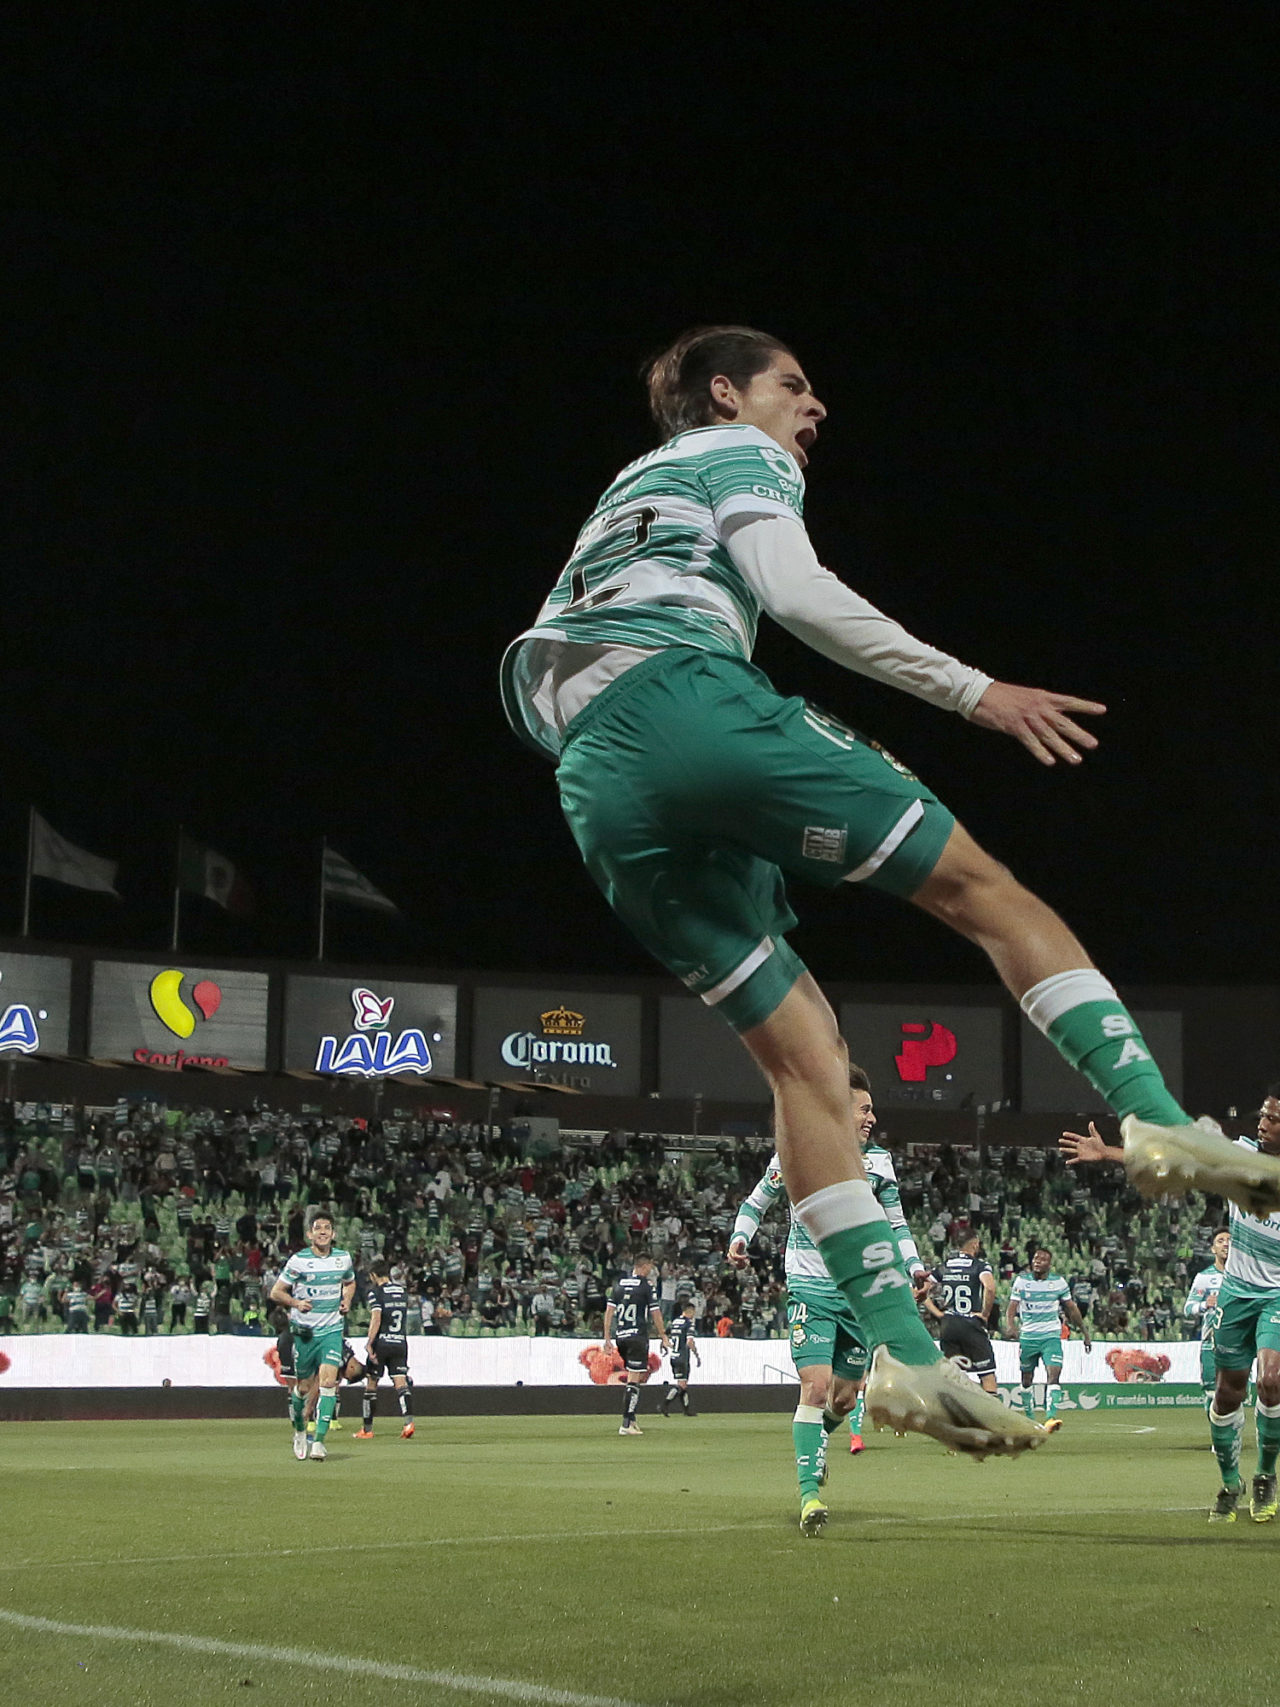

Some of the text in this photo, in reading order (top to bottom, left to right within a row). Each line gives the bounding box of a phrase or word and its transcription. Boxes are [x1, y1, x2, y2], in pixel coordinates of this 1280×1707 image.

[315, 1030, 433, 1077] LALA
[942, 1284, 972, 1313] 26
[388, 1309, 403, 1332] 3
[616, 1303, 637, 1326] 24
